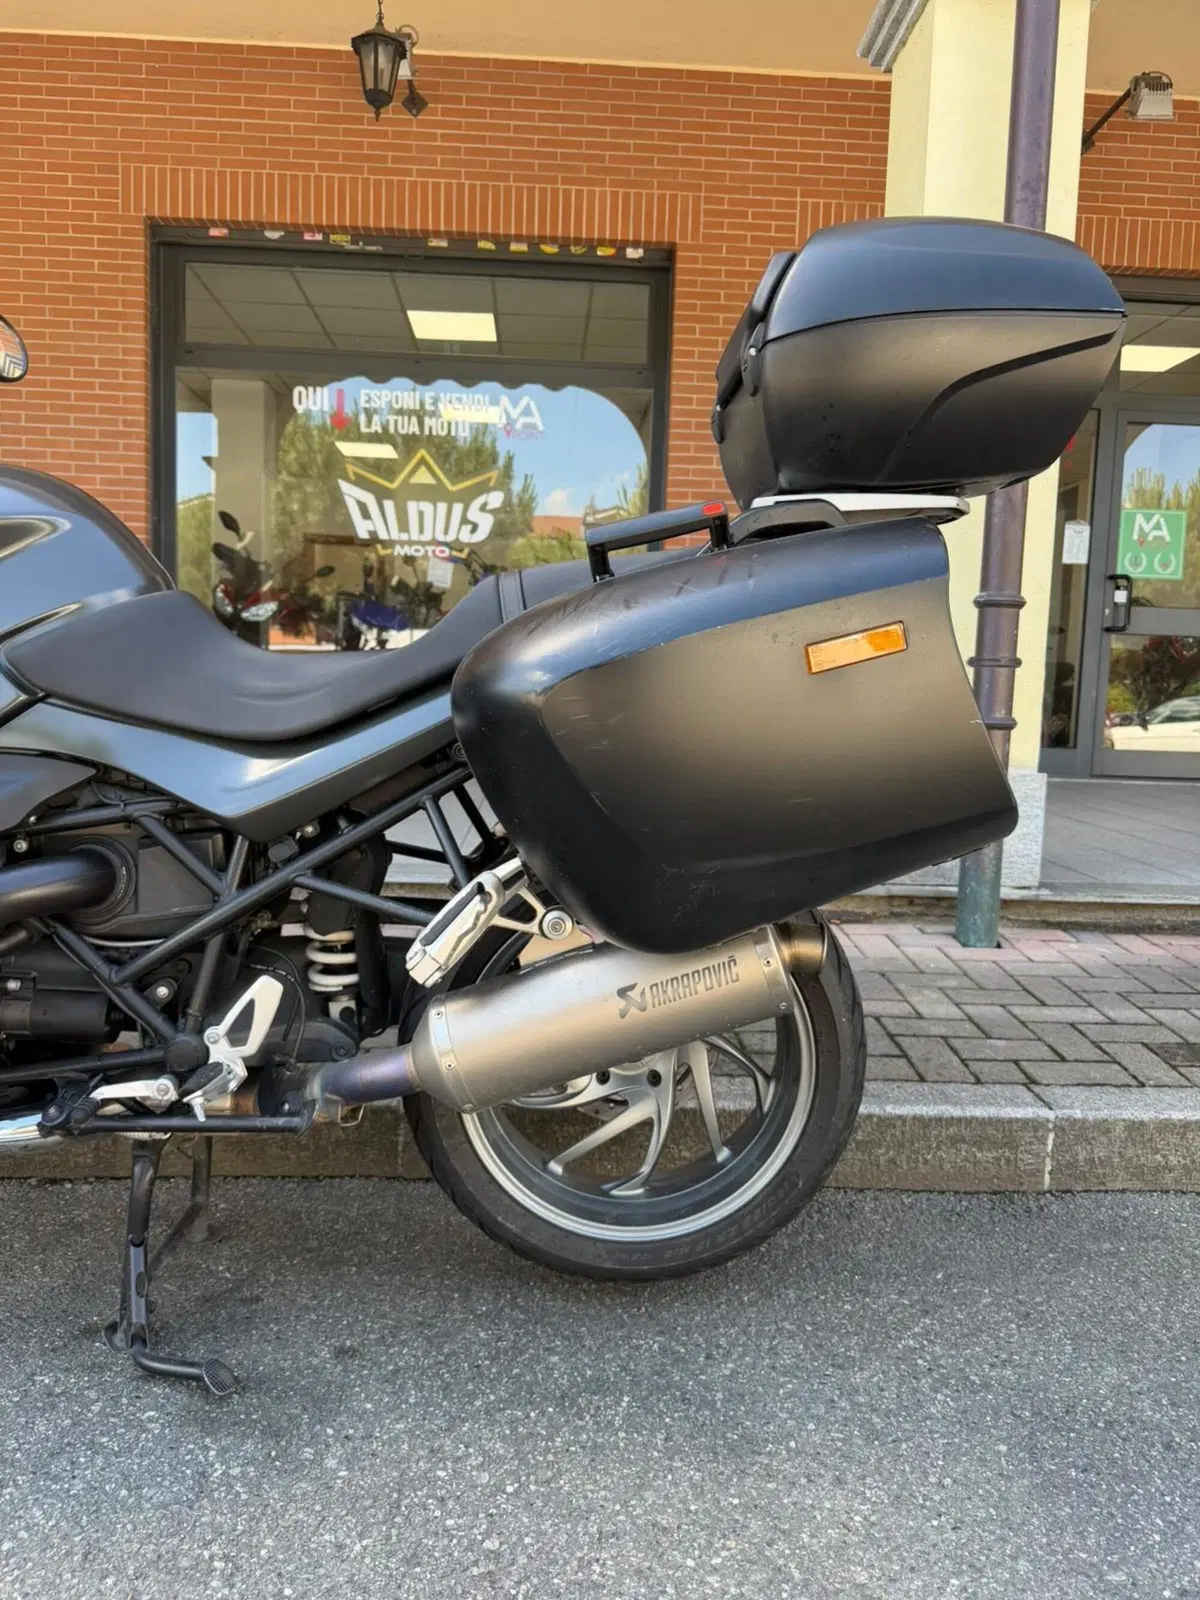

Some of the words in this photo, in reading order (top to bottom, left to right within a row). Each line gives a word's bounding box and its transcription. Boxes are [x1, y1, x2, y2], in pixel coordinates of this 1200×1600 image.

[292, 386, 329, 413] QUI
[360, 389, 420, 409] ESPONI
[425, 392, 435, 410] E
[438, 393, 490, 412] VENDI
[360, 414, 383, 433] LA
[388, 416, 421, 435] TUA
[423, 417, 469, 437] MOTO
[337, 478, 505, 543] ALDUS
[393, 544, 450, 557] MOTO
[650, 955, 740, 1008] AKRAPOVIČ
